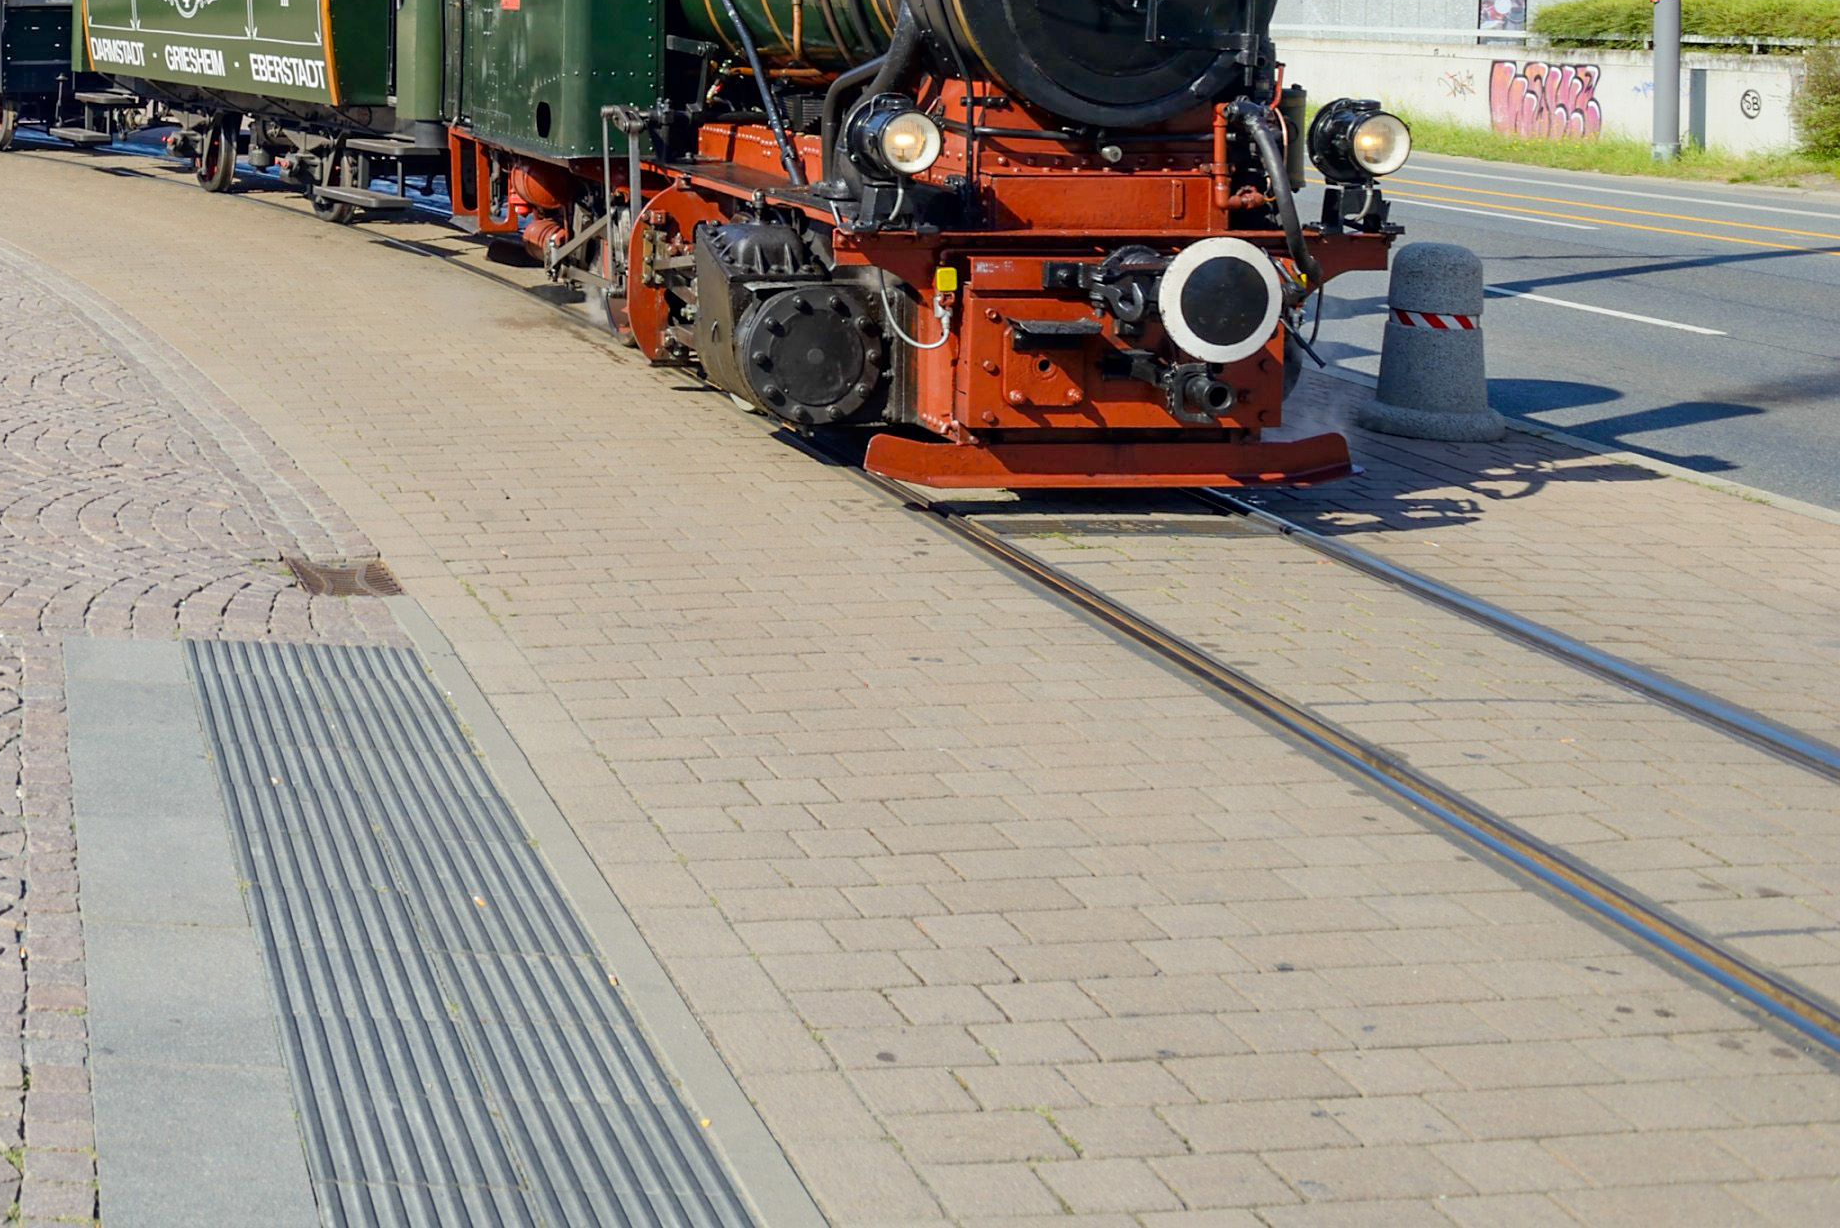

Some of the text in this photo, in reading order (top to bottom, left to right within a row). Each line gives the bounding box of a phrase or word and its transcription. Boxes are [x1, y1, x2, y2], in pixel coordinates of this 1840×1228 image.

[90, 37, 326, 90] DARMSTADT GRIESHEIM EBERSTADT
